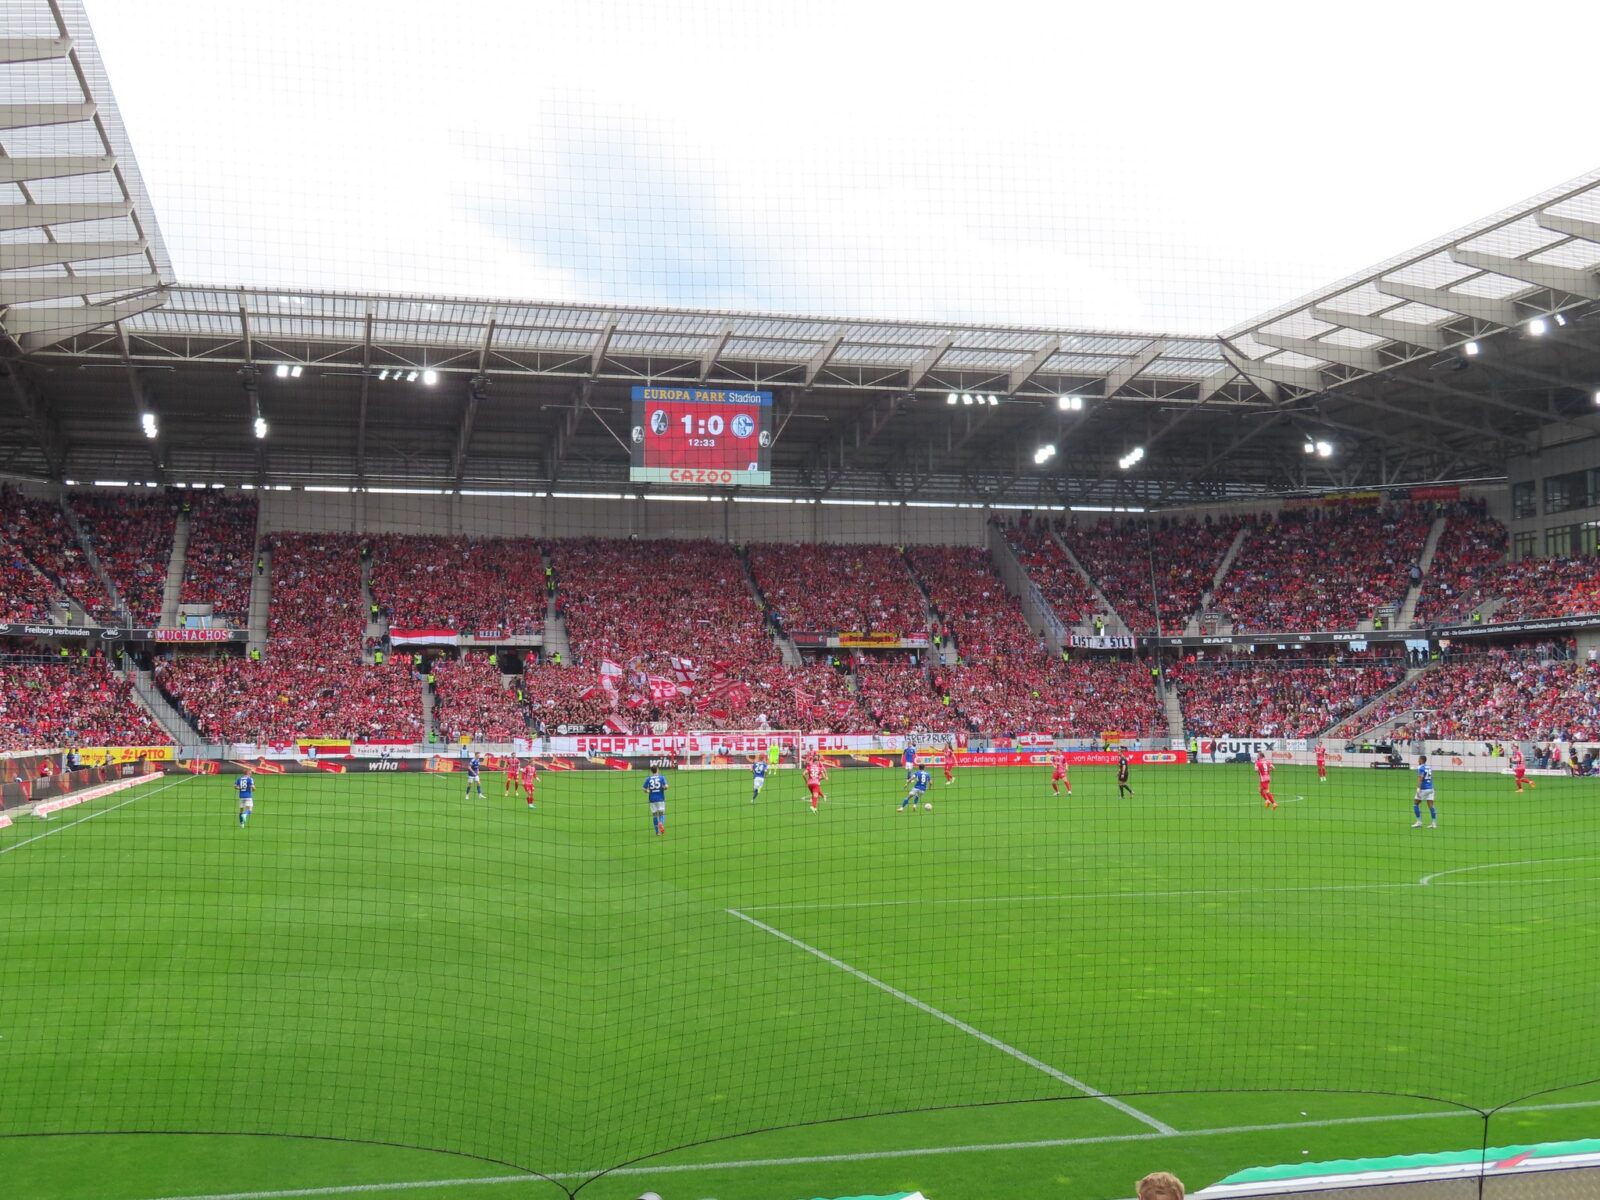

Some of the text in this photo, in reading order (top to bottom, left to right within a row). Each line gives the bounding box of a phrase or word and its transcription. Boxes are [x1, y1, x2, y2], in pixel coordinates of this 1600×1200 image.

[643, 388, 761, 404] EUROPA PARK Stadion
[680, 414, 724, 436] 1:0
[688, 438, 715, 448] 12:33
[669, 469, 732, 483] CAZOO
[24, 626, 90, 637] Freiburg verbunden
[156, 630, 228, 641] MUCHACHOS
[1072, 636, 1133, 648] LIST SYLT
[1217, 741, 1275, 755] GUTEX
[134, 748, 165, 761] LOTTO
[368, 759, 398, 771] wiha
[240, 779, 248, 789] 18
[649, 777, 661, 790] 35
